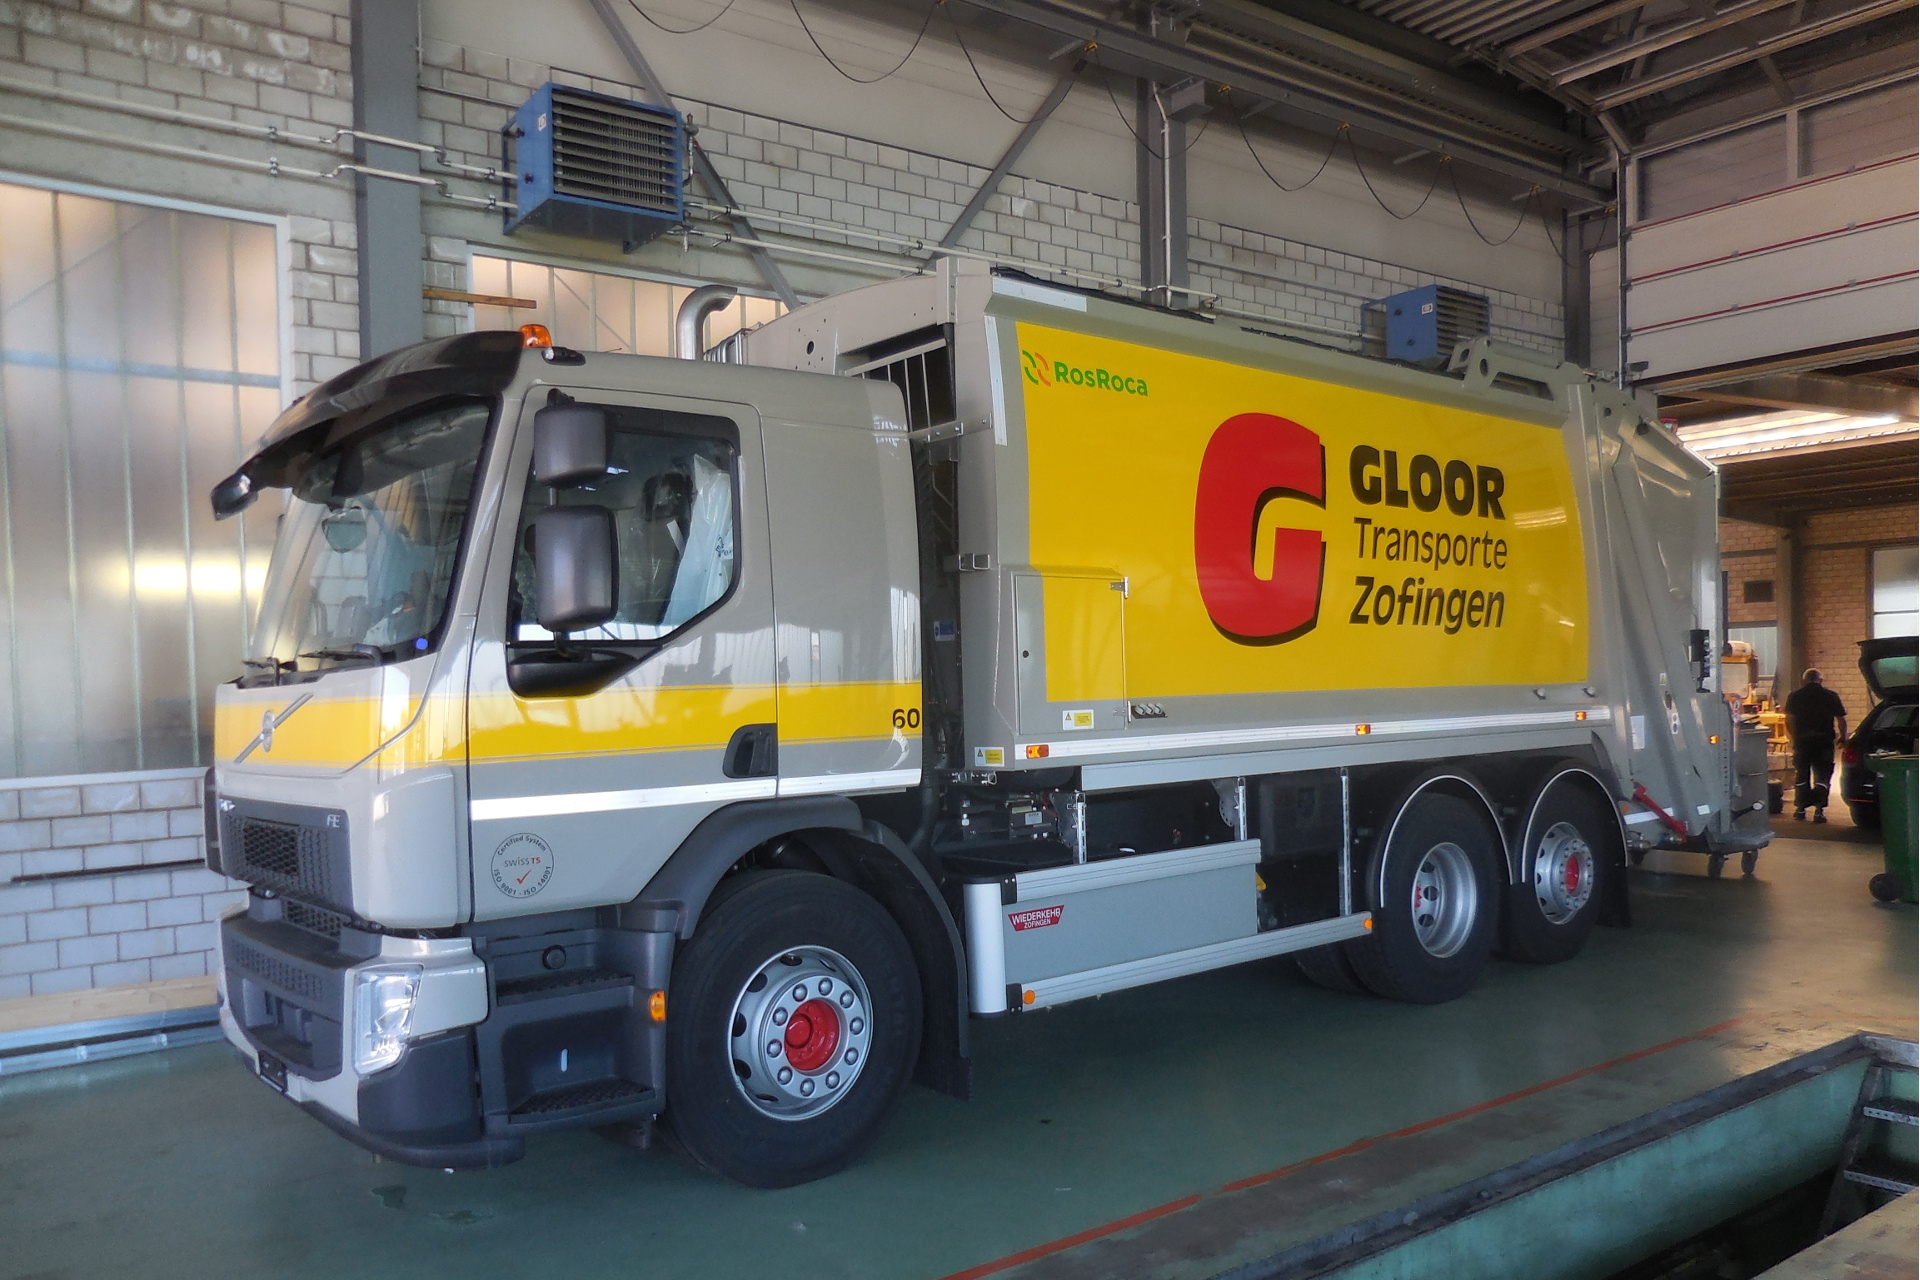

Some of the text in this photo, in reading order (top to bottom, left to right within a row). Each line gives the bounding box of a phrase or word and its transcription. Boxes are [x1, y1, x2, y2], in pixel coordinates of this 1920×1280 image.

[1054, 360, 1148, 397] RosRoca
[1349, 444, 1506, 520] GLOOR
[1194, 412, 1327, 648] G
[1353, 516, 1508, 571] Transporte
[1350, 575, 1506, 635] Zofingen
[892, 708, 920, 729] 60
[326, 814, 341, 828] FE
[497, 835, 546, 856] Certified System
[493, 869, 503, 883] ISO
[500, 882, 517, 896] 9001
[523, 886, 537, 896] ISO
[537, 866, 551, 887] 14001
